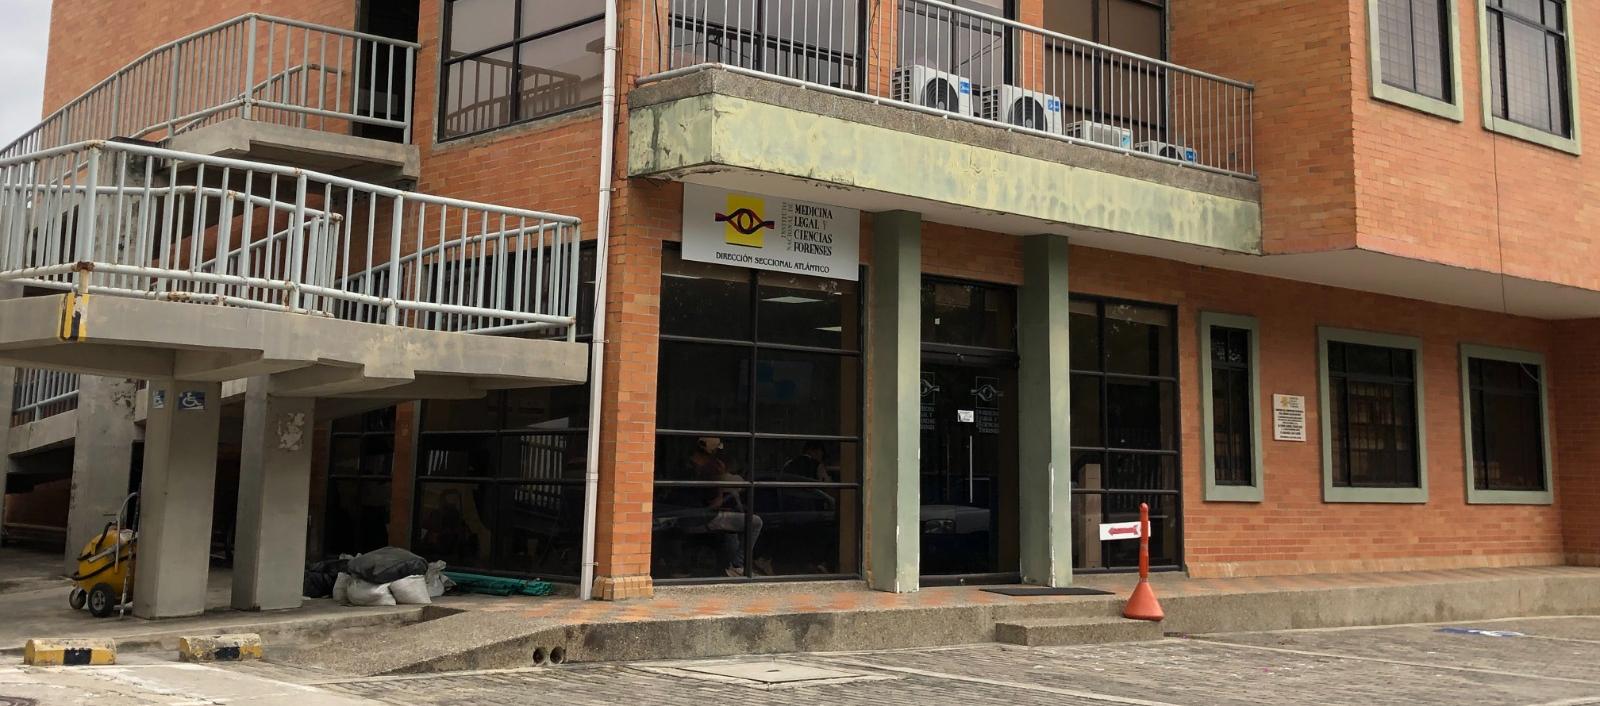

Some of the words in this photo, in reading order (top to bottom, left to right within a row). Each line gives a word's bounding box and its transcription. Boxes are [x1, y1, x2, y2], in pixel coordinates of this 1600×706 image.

[795, 204, 833, 219] MEDICINA
[794, 216, 819, 230] LEGAL
[794, 229, 832, 244] CIENCIAS
[793, 242, 832, 256] FORENSES
[716, 251, 753, 263] DIRECCIÓN
[754, 257, 792, 269] SECCIONAL
[794, 262, 830, 274] ATLÁNTICO
